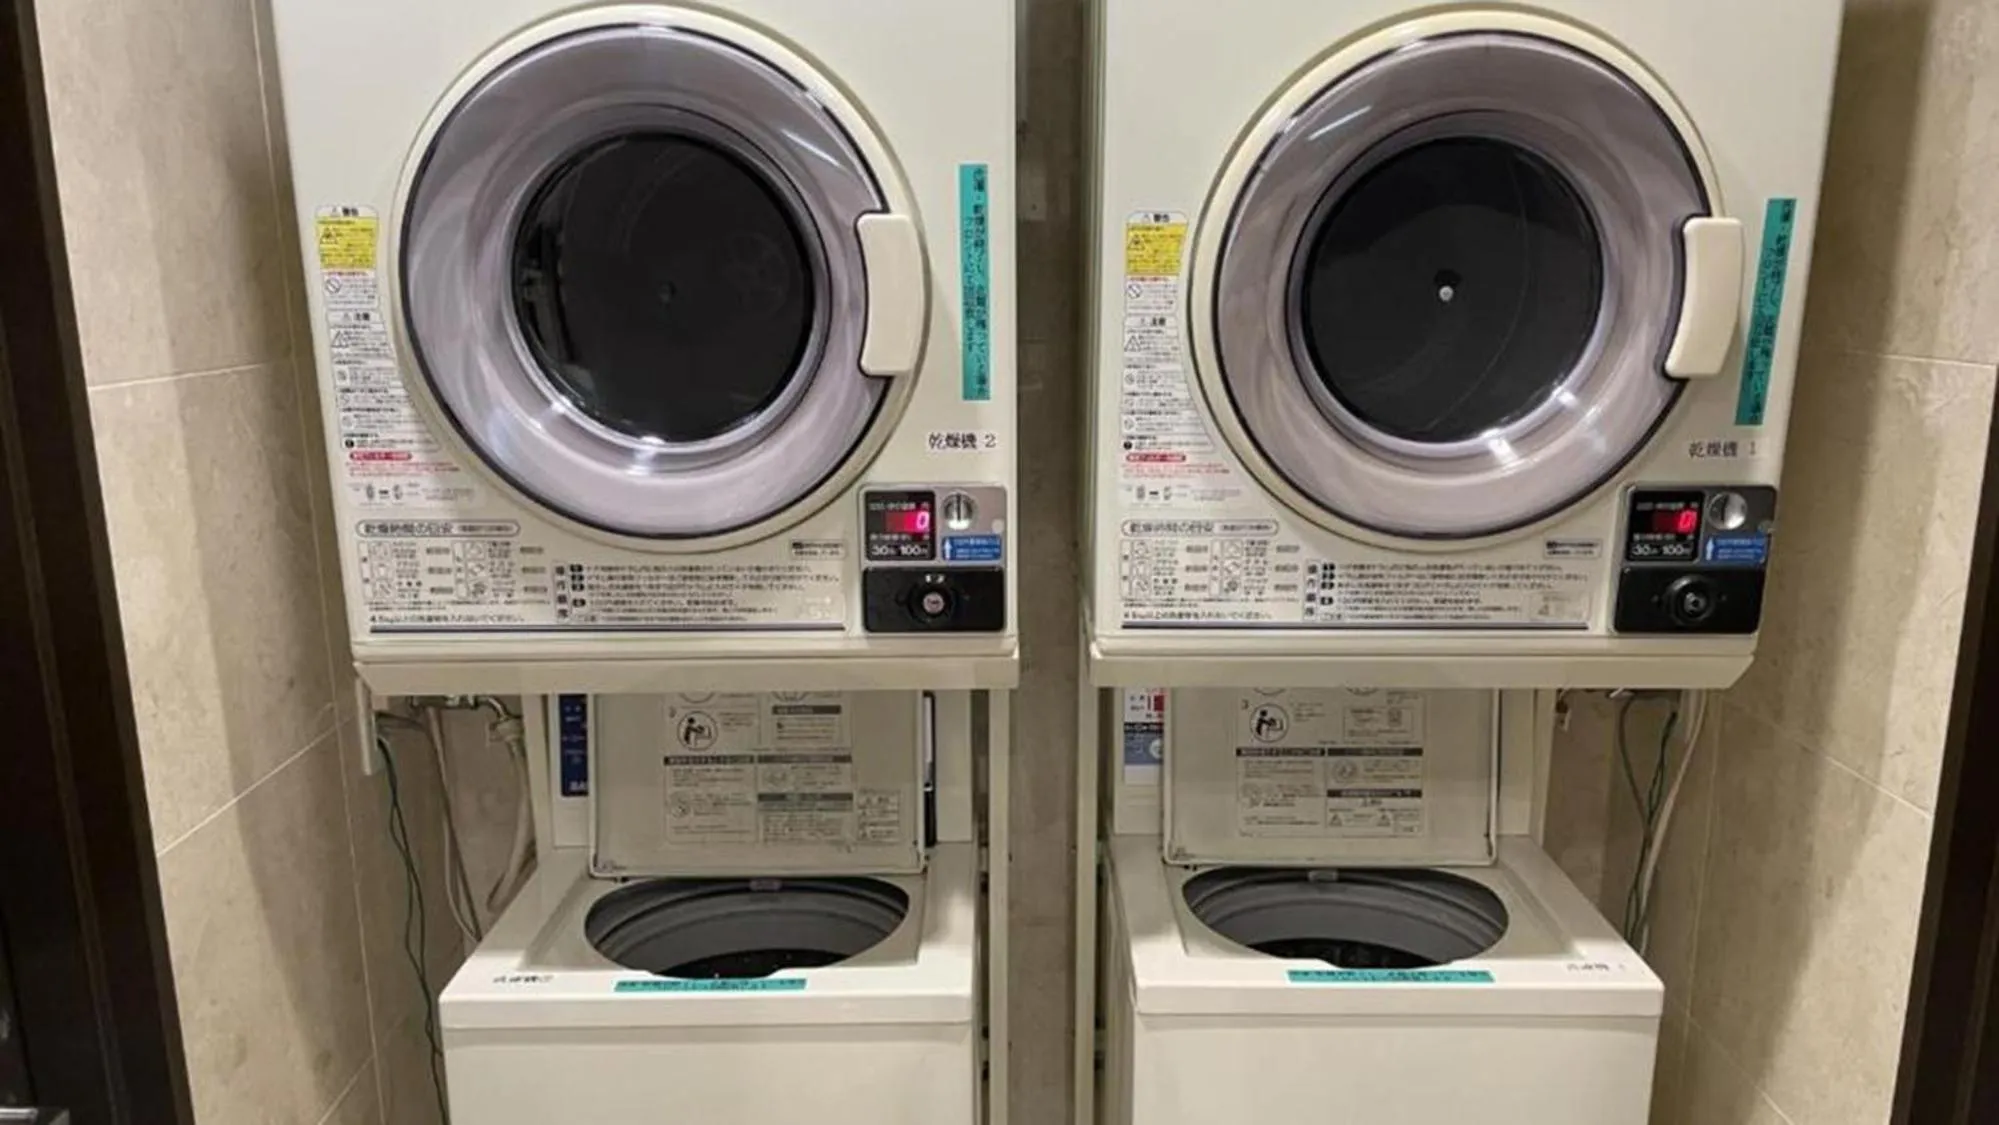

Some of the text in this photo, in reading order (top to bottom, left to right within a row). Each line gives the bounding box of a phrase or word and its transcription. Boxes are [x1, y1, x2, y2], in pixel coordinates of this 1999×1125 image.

[928, 432, 997, 450] 乾燥機 2
[1688, 440, 1757, 459] 乾燥機 1
[916, 511, 930, 531] 0
[1678, 510, 1698, 533] 0
